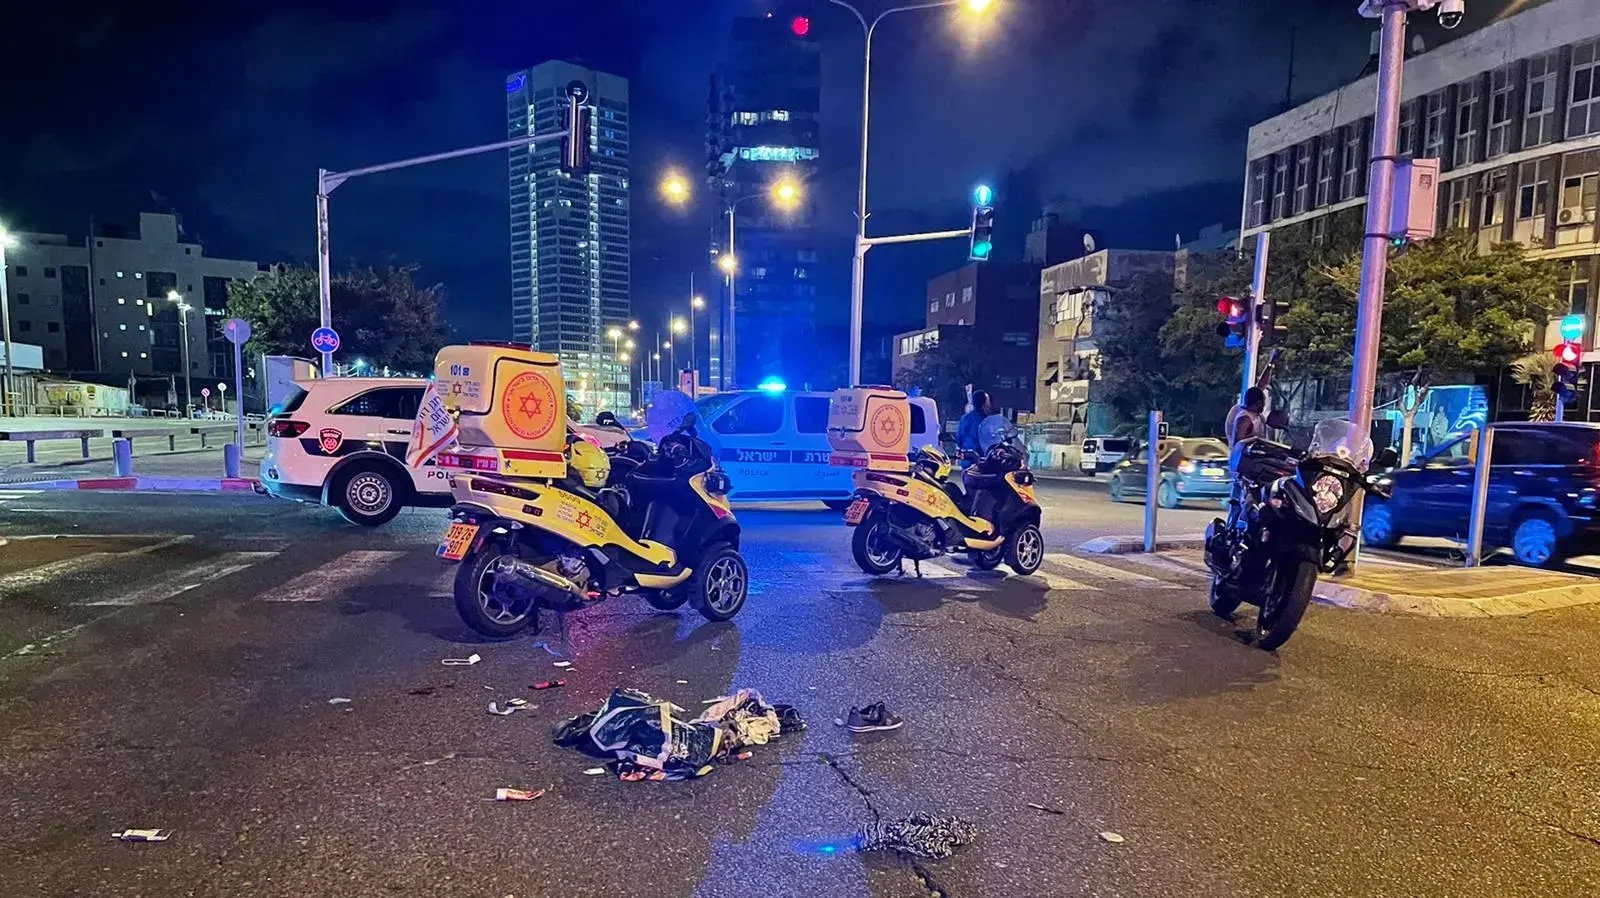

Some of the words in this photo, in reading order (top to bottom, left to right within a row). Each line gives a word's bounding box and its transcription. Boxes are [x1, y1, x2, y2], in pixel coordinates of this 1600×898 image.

[430, 406, 446, 422] דום
[427, 413, 450, 435] ישראל
[736, 449, 777, 462] ישראל
[804, 451, 831, 463] טרת
[427, 471, 449, 480] POL
